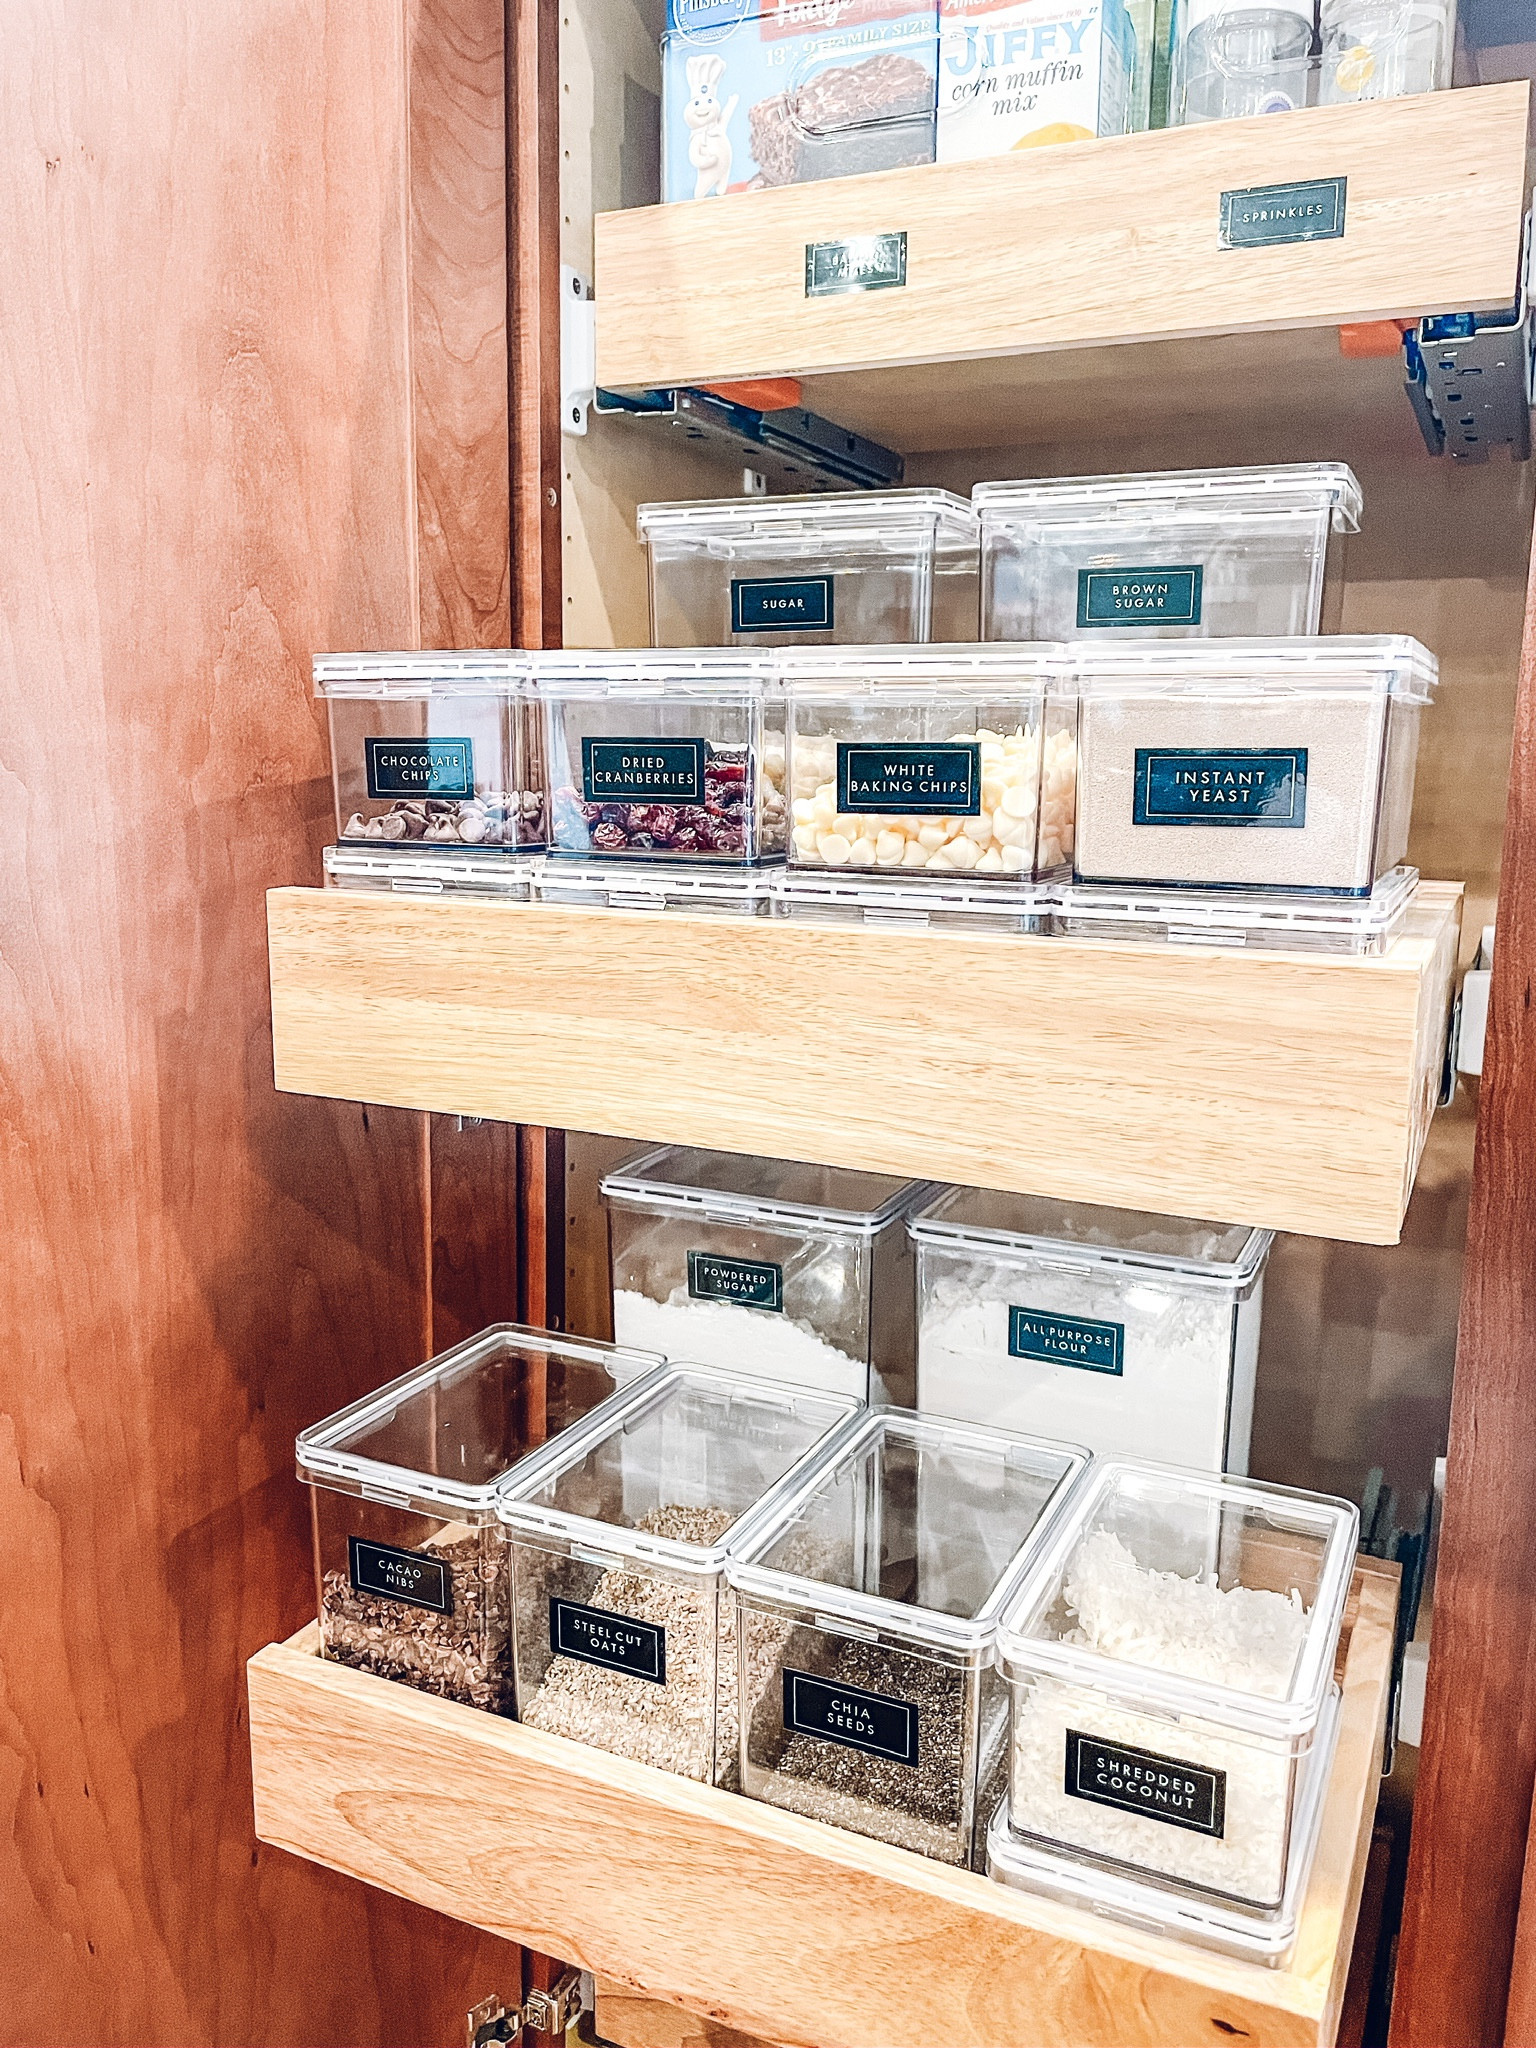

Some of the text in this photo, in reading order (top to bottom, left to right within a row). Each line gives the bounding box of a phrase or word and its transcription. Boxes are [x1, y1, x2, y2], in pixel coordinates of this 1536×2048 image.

[681, 0, 744, 15] Pills
[891, 18, 932, 36] SIZE
[952, 59, 1084, 101] corn muffin
[993, 91, 1038, 116] mix
[1242, 204, 1323, 224] SPRINKLES
[1112, 583, 1168, 596] BROWN
[762, 598, 804, 610] SUGAR
[1114, 597, 1165, 609] SUGAR
[380, 755, 459, 767] CHOCOLATE
[621, 756, 665, 769] DRIED
[401, 770, 439, 781] CHIPS
[595, 771, 694, 785] CRANBERRIES
[883, 764, 935, 777] WHITE
[1175, 771, 1266, 785] INSTANT
[850, 780, 967, 793] BAKING CHIPS
[1189, 789, 1251, 803] YEAST
[704, 1266, 767, 1285] POWDERED
[716, 1279, 755, 1294] SUGAR
[1049, 1326, 1111, 1347] PURPOSE
[1044, 1338, 1087, 1355] FLOUR
[378, 1559, 422, 1579] CACAO
[386, 1573, 414, 1589] NIBS
[573, 1619, 642, 1647] STEEL CUT
[590, 1637, 626, 1656] OATS
[831, 1699, 871, 1720] CHIA
[826, 1712, 875, 1735] SEEDS
[1096, 1757, 1196, 1794] SHREDDED
[1096, 1772, 1195, 1809] COCONUT
